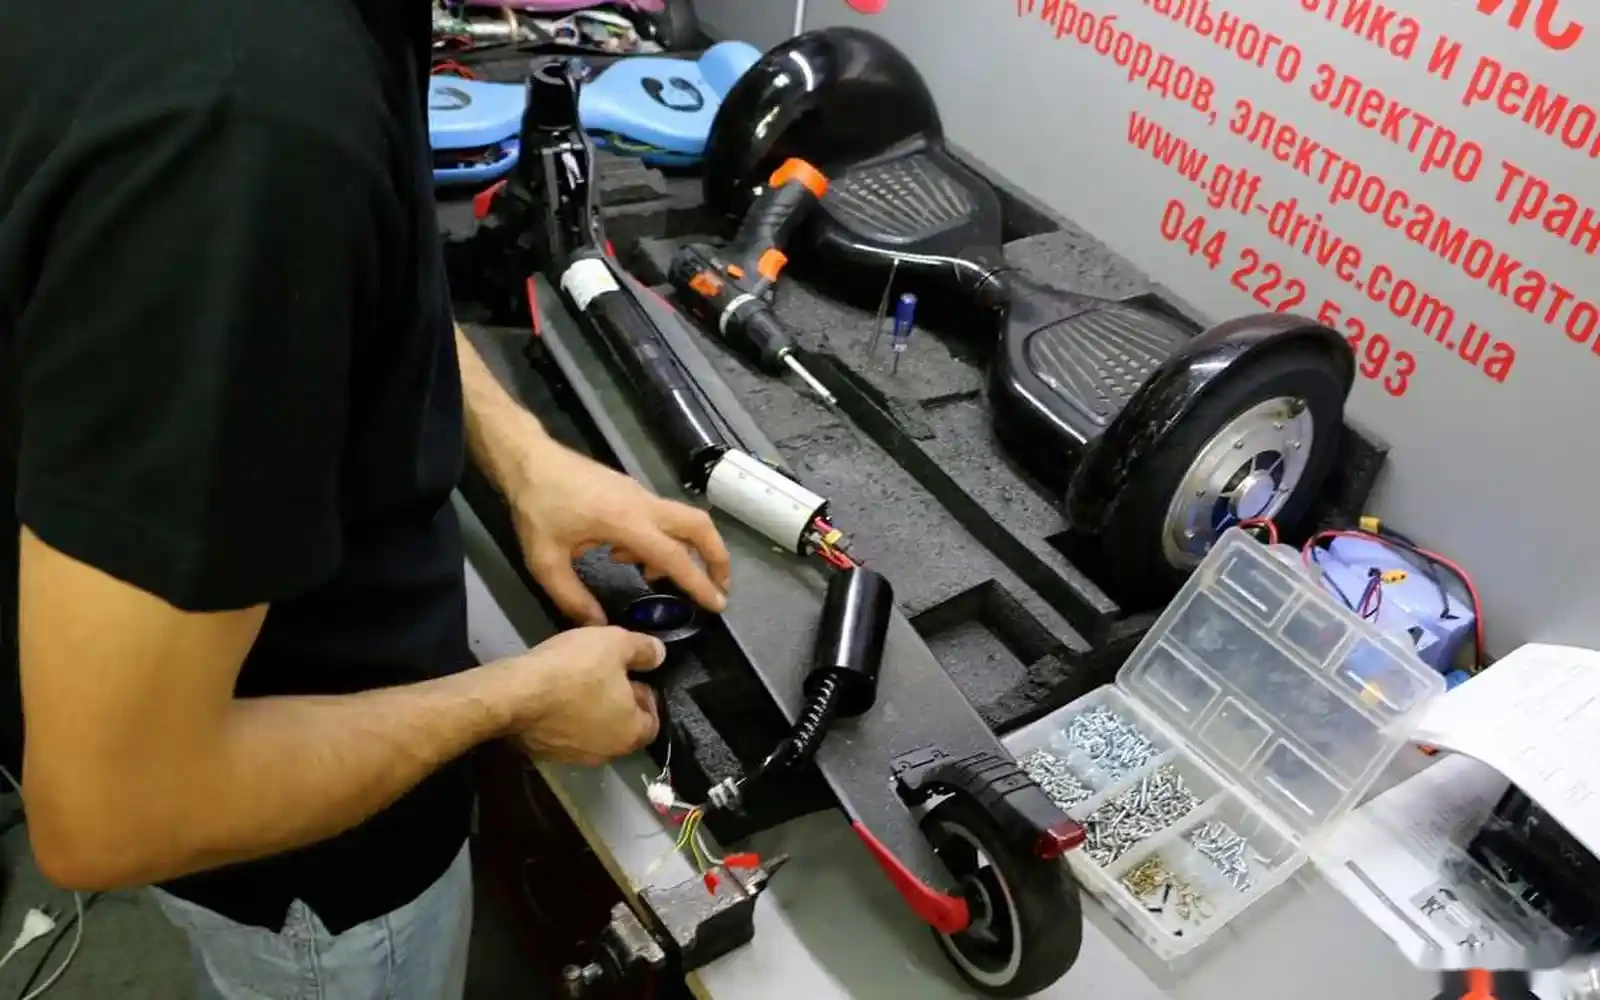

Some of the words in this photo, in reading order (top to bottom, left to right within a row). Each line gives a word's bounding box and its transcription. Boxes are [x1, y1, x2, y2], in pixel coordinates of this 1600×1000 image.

[1427, 35, 1462, 81] и
[1310, 63, 1482, 181] электро
[1127, 110, 1516, 383] www.gtf-drive.com.ua
[1160, 199, 1227, 271] 044
[1229, 247, 1306, 314] 222
[1230, 99, 1600, 357] электросамокато
